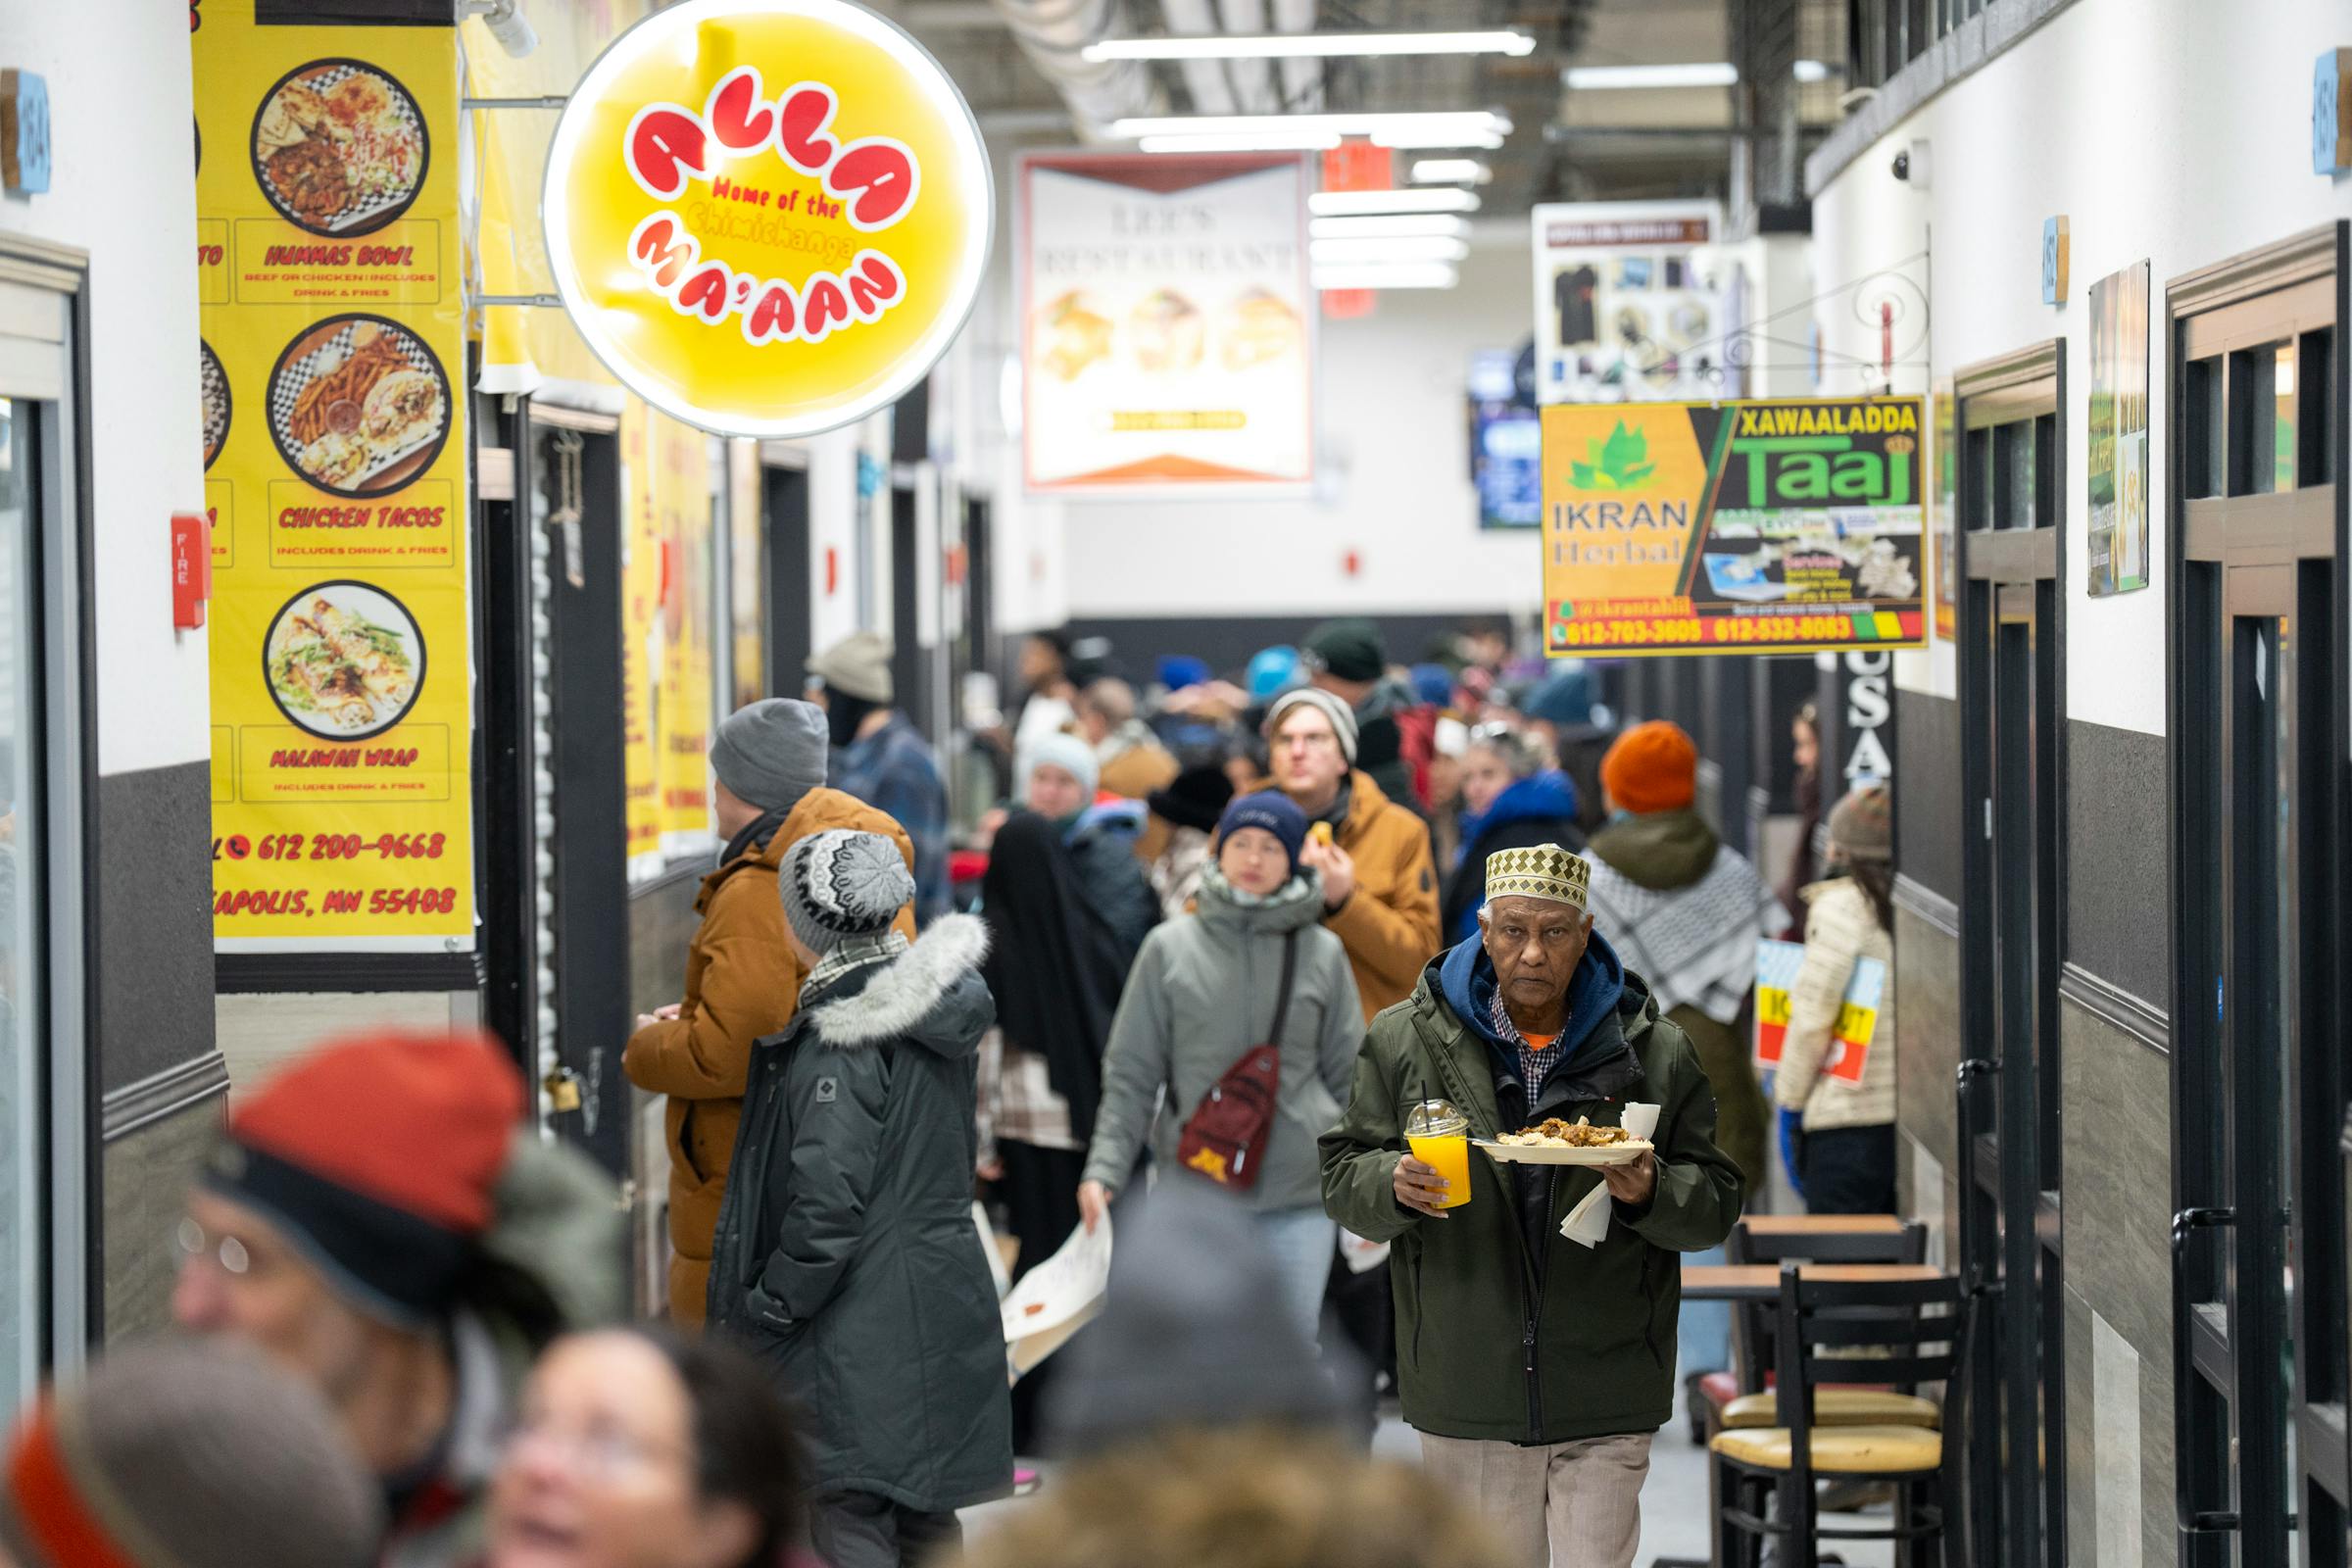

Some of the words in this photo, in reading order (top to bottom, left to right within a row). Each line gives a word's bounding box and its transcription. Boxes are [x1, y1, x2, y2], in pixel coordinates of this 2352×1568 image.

[628, 70, 916, 227] ALLA
[712, 176, 769, 207] Home
[778, 189, 800, 212] of
[807, 195, 841, 219] the
[686, 201, 858, 266] Chimichanga
[356, 245, 415, 267] BOWL
[245, 273, 279, 282] BEEF
[632, 215, 902, 341] MA'AAN
[293, 288, 336, 298] DRINK
[352, 288, 390, 298] FRIES
[1740, 406, 1917, 436] XAWAALADDA
[1732, 435, 1914, 508] Taaj
[278, 507, 371, 528] CHICKEN
[377, 507, 446, 528] TACOS
[1553, 501, 1688, 530] IKRAN
[176, 533, 189, 585] FIRE
[276, 547, 345, 556] INCLUDES
[348, 546, 393, 555] DRINK
[409, 546, 448, 555] FRIES
[1554, 538, 1683, 565] Herbal
[269, 748, 361, 768] MALAWAH
[365, 747, 418, 767] WRAP
[258, 834, 305, 860] 612
[213, 889, 315, 917] APOLIS,
[321, 889, 364, 913] MN
[368, 888, 457, 914] 55408
